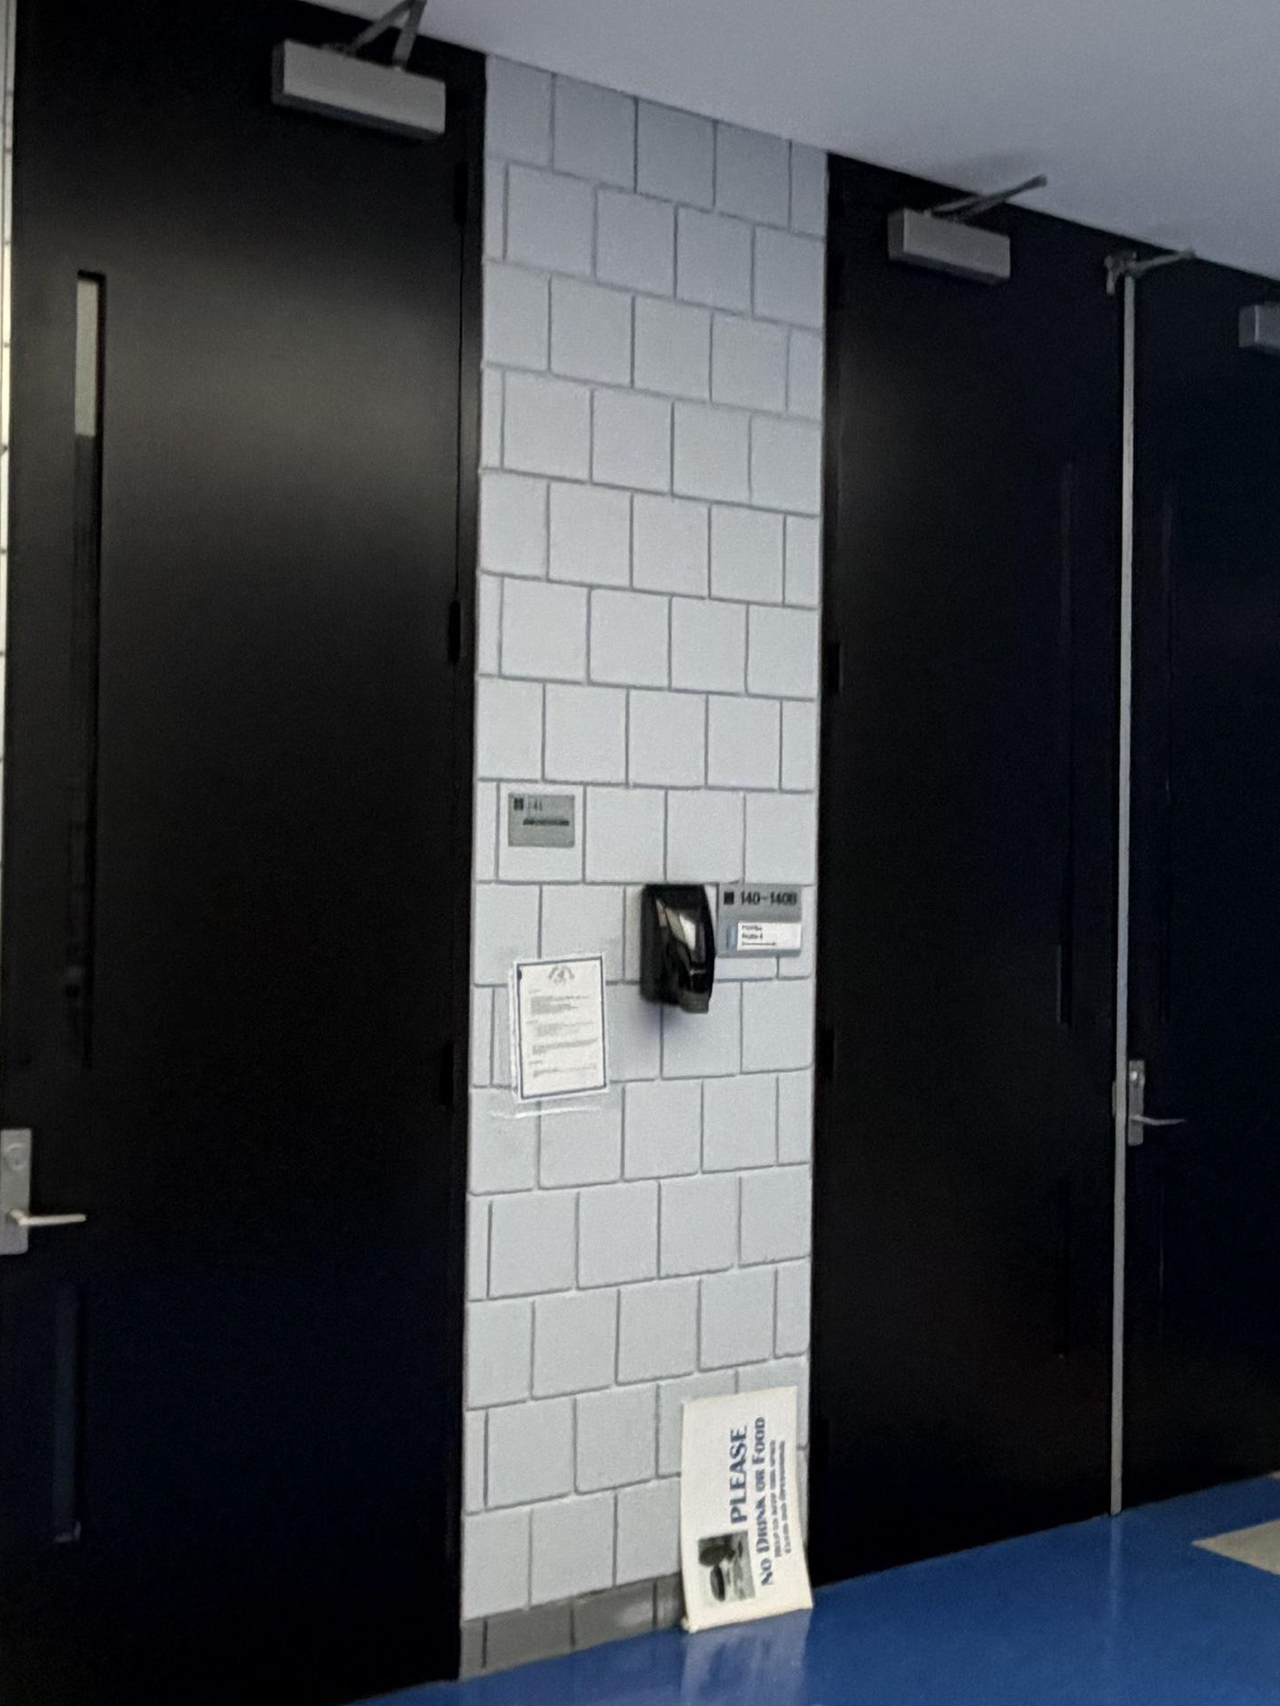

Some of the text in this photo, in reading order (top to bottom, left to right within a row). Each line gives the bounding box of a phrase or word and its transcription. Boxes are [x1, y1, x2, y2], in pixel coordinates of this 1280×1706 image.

[752, 1417, 766, 1465] FOOD
[730, 1425, 748, 1524] PLEASE
[755, 1495, 770, 1554] DRINK
